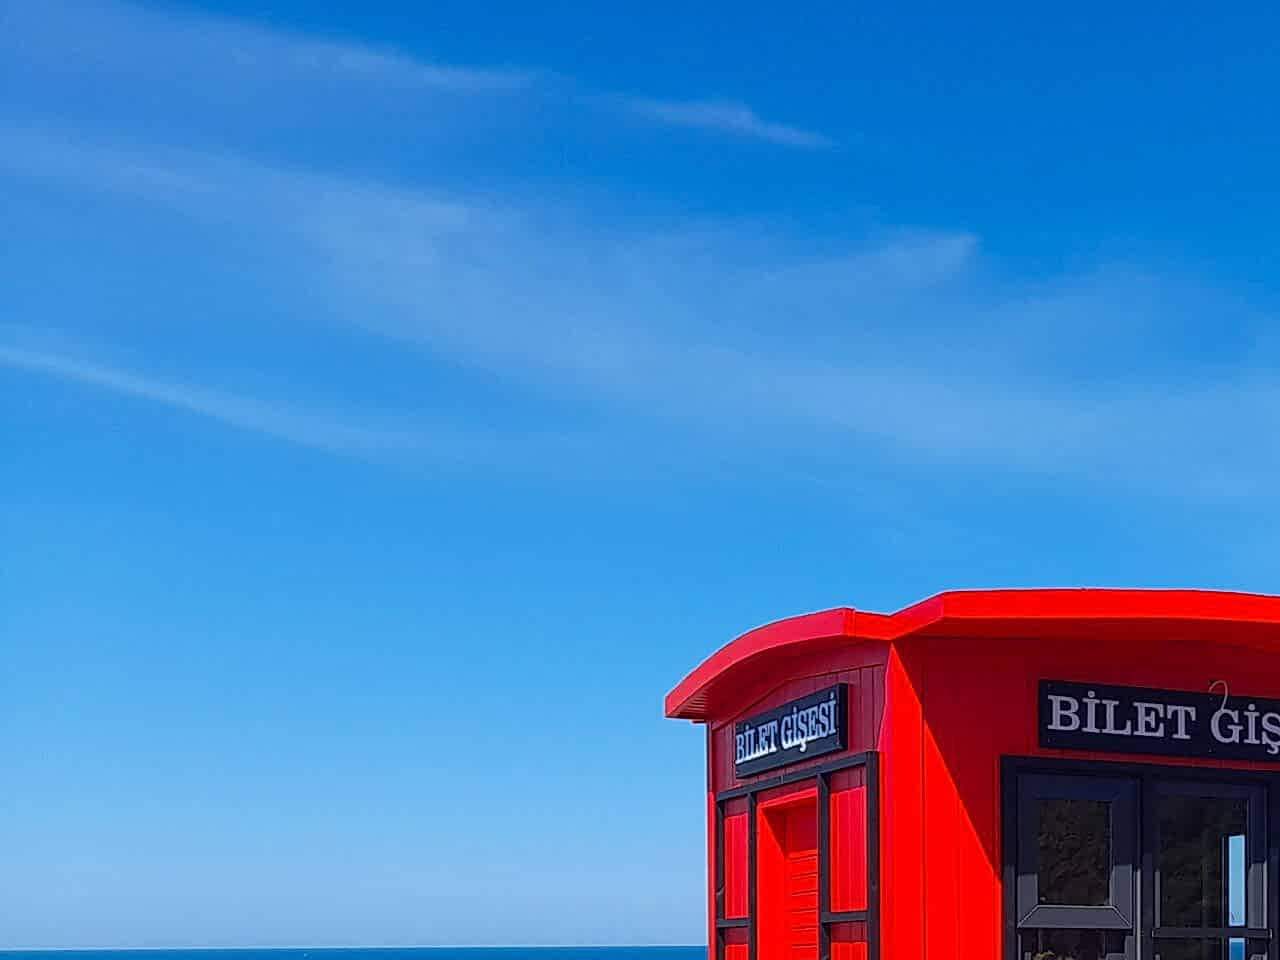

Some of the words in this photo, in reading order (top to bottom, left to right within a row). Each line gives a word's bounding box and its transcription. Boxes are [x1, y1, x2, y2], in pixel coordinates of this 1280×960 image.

[735, 720, 778, 764] BİLET
[781, 692, 836, 752] GİŞESİ
[1048, 691, 1196, 739] BİLET
